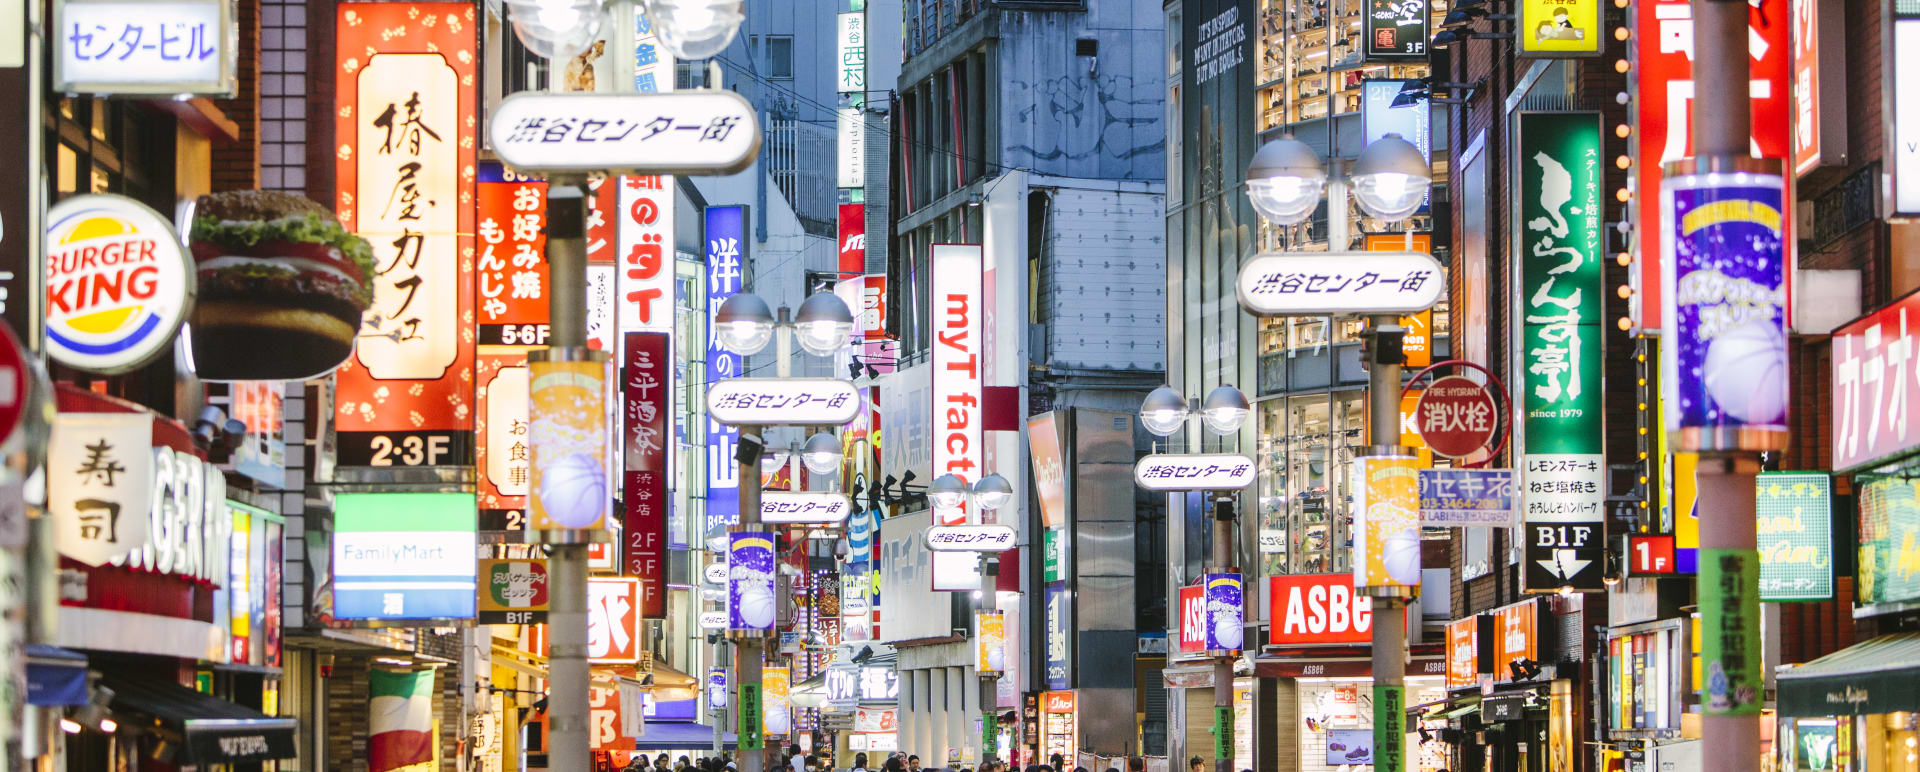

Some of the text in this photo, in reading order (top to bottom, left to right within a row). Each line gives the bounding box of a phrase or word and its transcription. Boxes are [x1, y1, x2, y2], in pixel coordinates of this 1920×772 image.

[847, 17, 861, 43] 渋谷
[69, 23, 215, 61] センタービル
[1406, 42, 1423, 53] 3F
[506, 116, 742, 142] 渋谷センター街
[511, 185, 543, 300] お好み焼
[478, 217, 508, 320] もんじゃ
[47, 265, 160, 314] KING
[1251, 270, 1432, 294] 渋谷センター街
[708, 237, 740, 489] 洋の山
[714, 392, 851, 409] 渋谷センター街
[1429, 387, 1446, 397] FIRE
[1424, 402, 1489, 433] 消火栓
[1530, 409, 1583, 419] since 1979
[1143, 464, 1250, 479] 渋谷センター街
[1528, 460, 1598, 473] レモンステーキ
[75, 439, 125, 543] 寿司
[635, 473, 653, 517] 渋谷店
[1529, 481, 1597, 494] ねぎ塩焼き
[631, 532, 657, 547] 2F
[931, 532, 1011, 544] 渋谷センター街
[1536, 526, 1592, 547] B1F
[343, 543, 445, 565] FamilyMart
[1635, 541, 1667, 571] 1F
[493, 571, 547, 584] スパゲッティ
[631, 560, 657, 575] 3F
[506, 612, 533, 624] B1F
[1184, 596, 1205, 643] ASB
[1284, 584, 1373, 635] ASBe
[1302, 665, 1324, 675] ASBee
[1424, 662, 1446, 673] ASBee
